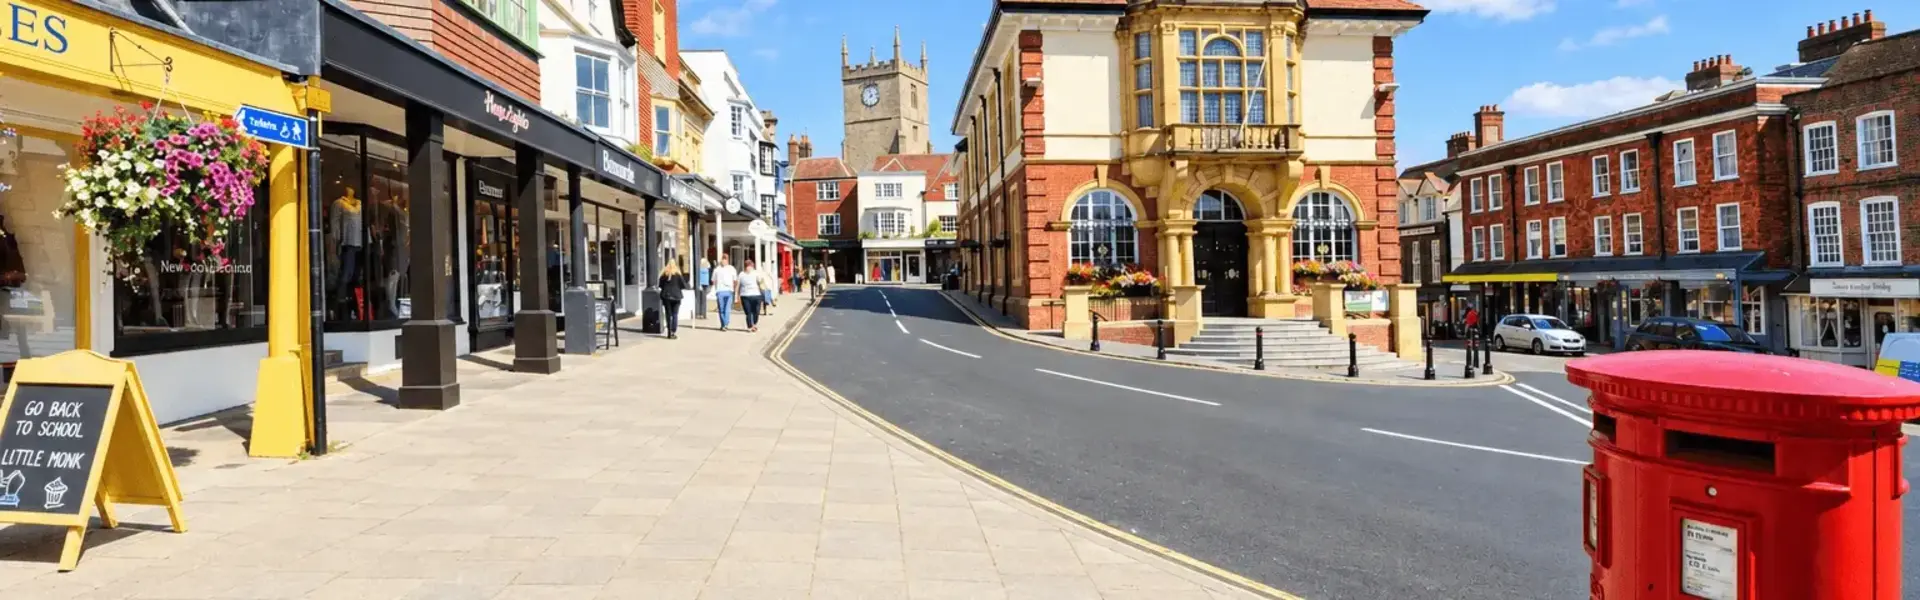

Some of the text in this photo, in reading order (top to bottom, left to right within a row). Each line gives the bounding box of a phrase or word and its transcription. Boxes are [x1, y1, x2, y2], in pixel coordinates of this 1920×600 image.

[0, 2, 68, 53] ES
[160, 260, 183, 273] New
[24, 400, 84, 418] GO BACK
[15, 420, 84, 438] TO SCHOOL
[1, 448, 85, 469] LITTLE MONK
